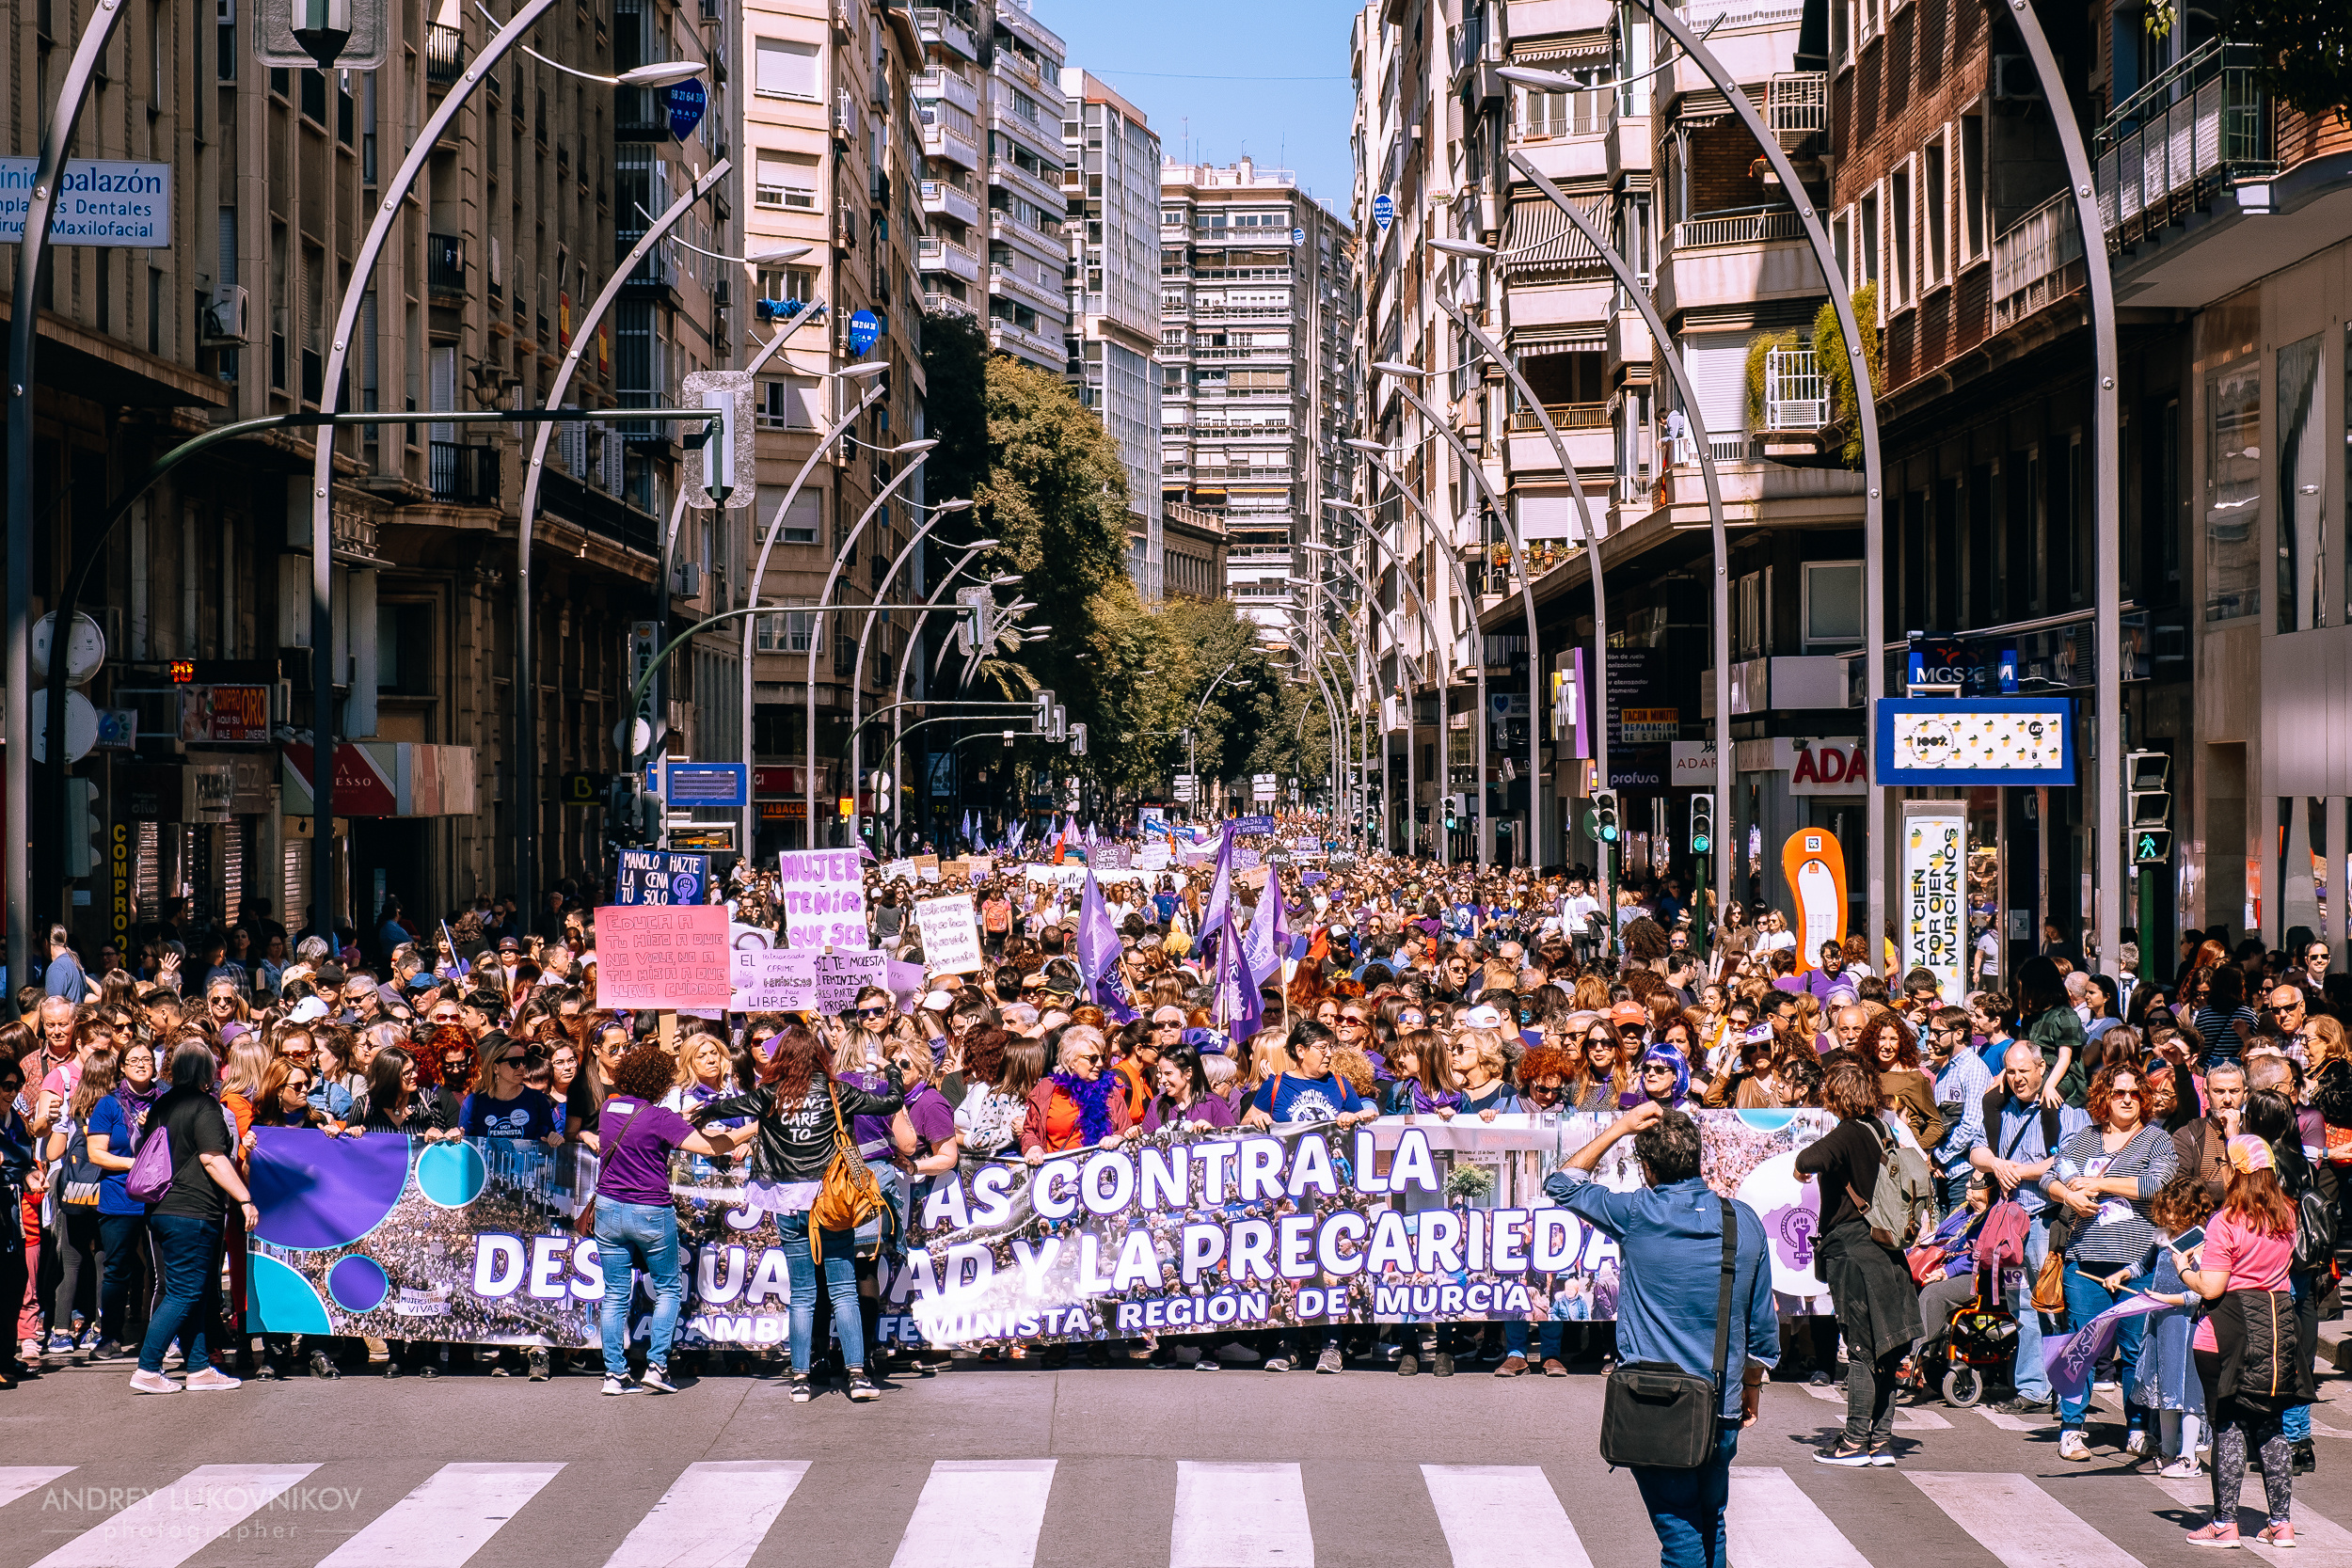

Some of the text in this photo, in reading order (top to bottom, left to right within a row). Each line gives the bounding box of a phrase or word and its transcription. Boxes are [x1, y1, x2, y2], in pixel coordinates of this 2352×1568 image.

[59, 166, 161, 197] palazón
[75, 198, 151, 216] Dentales
[51, 219, 153, 238] Maxilofacial
[1915, 667, 1965, 683] MGS
[214, 689, 266, 726] COMPRO ORO
[231, 716, 241, 725] SU
[1624, 722, 1677, 732] REPARACION
[215, 730, 230, 739] VALE
[245, 730, 266, 739] DINERO
[1624, 733, 1634, 741] DE
[1610, 771, 1660, 786] profusa
[762, 803, 808, 815] TABACOS
[623, 851, 702, 875] MANOLO HAZTE
[782, 852, 860, 882] MUJER
[113, 824, 127, 930] COMPRO
[621, 869, 669, 890] LA CENA
[643, 889, 668, 906] SOLO
[1944, 828, 1957, 967] MURCIANOS
[605, 913, 693, 931] EDUCA A
[1913, 867, 1926, 967] LAT CIEN
[675, 933, 688, 946] A
[692, 933, 723, 947] QUE
[788, 922, 867, 949] QUE SER
[1929, 918, 1941, 967] POR
[605, 953, 629, 967] NO
[677, 951, 696, 963] NO
[702, 951, 715, 963] A
[740, 954, 756, 967] EL
[816, 956, 885, 973] SI TE MOLESTA
[607, 965, 725, 982] TU HIJA A QUE
[822, 974, 873, 987] FEMINISMO
[611, 983, 656, 999] LLEVE
[834, 988, 856, 998] PARTE
[748, 996, 799, 1008] LIBRES
[780, 1112, 820, 1127] CARE
[788, 1128, 811, 1142] TO
[1031, 1132, 1339, 1220] CONTRA
[1355, 1127, 1439, 1194] LA
[1012, 1236, 1065, 1299] Y
[1077, 1227, 1164, 1294] LA
[1179, 1206, 1622, 1287] PRECARIEDA
[407, 1304, 439, 1313] VIVAS
[878, 1307, 1092, 1344] FEMINISTA
[1117, 1285, 1268, 1331] REGIÓN
[1296, 1286, 1350, 1319] DE
[1375, 1282, 1534, 1317] MURCIA
